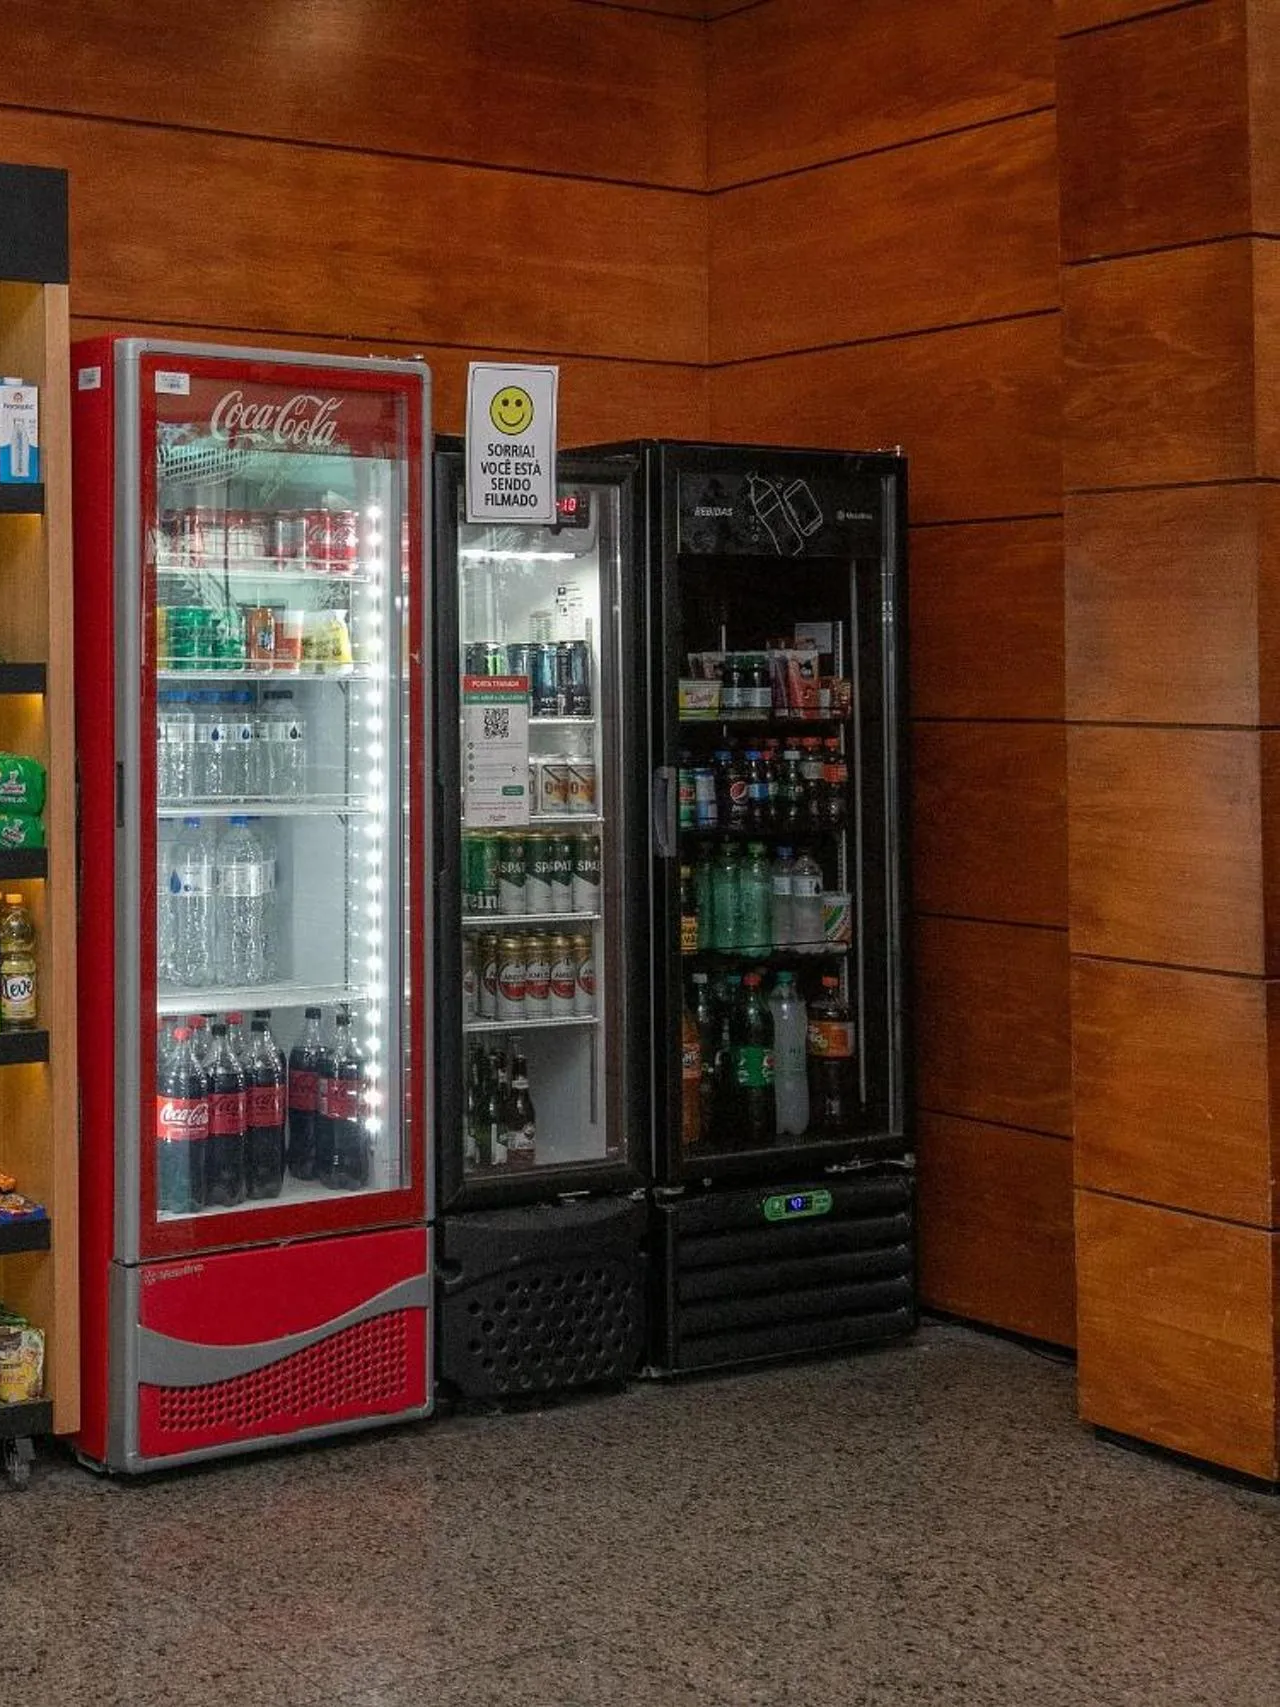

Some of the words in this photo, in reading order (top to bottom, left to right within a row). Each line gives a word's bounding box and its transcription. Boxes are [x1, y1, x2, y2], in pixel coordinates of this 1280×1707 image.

[210, 390, 344, 448] Coca-Cola
[487, 443, 536, 459] SORRIA!
[481, 459, 511, 475] VOCÊ
[515, 460, 542, 477] ESTÁ
[491, 478, 531, 492] SENDO
[484, 493, 538, 508] FILMADO
[160, 1104, 209, 1125] Coca-Cola
